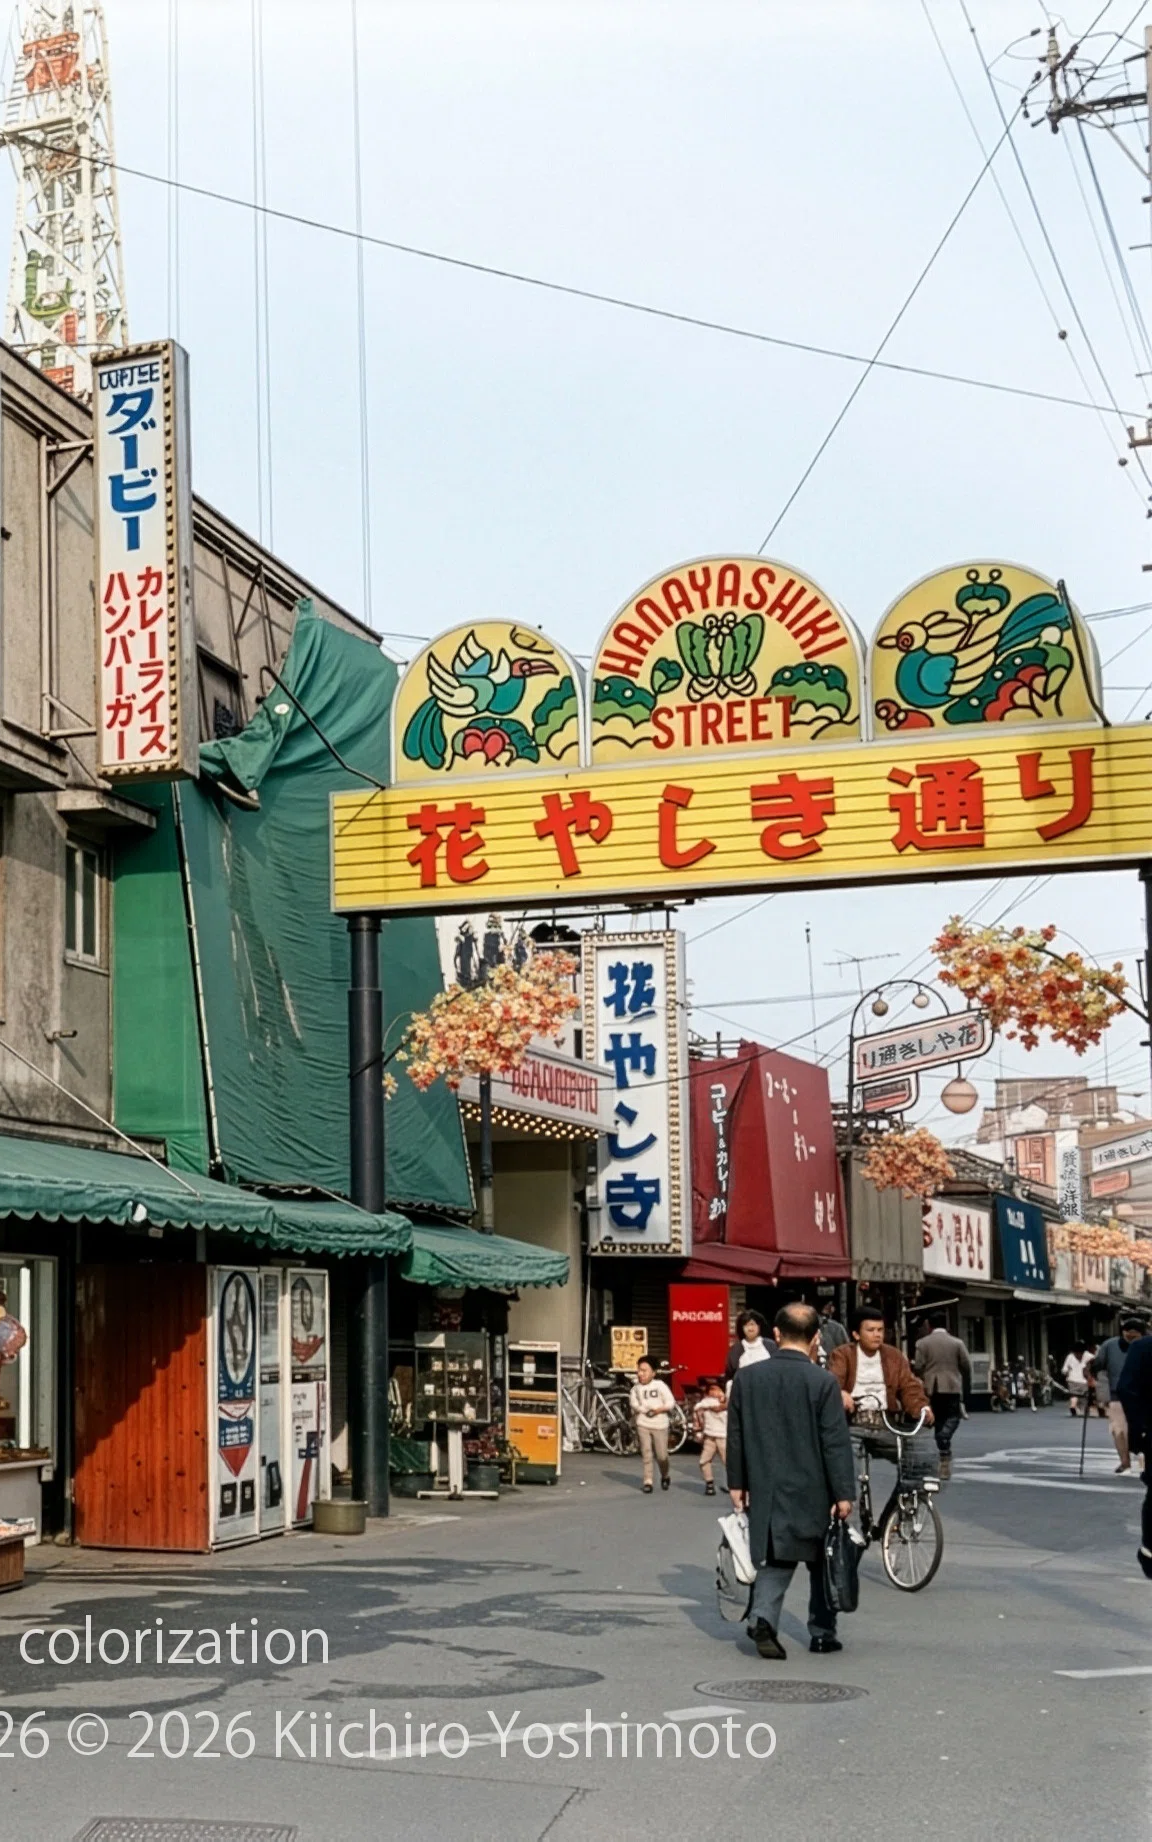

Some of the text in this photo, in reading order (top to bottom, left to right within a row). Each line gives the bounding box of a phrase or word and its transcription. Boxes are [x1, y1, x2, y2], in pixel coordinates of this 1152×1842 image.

[105, 387, 158, 551] ダービー
[104, 571, 137, 760] ハンバーガー
[136, 566, 168, 758] カレーライス
[598, 563, 849, 679] HANAYASHIKI
[651, 694, 797, 750] STREET
[405, 747, 1096, 889] 花やしき通り
